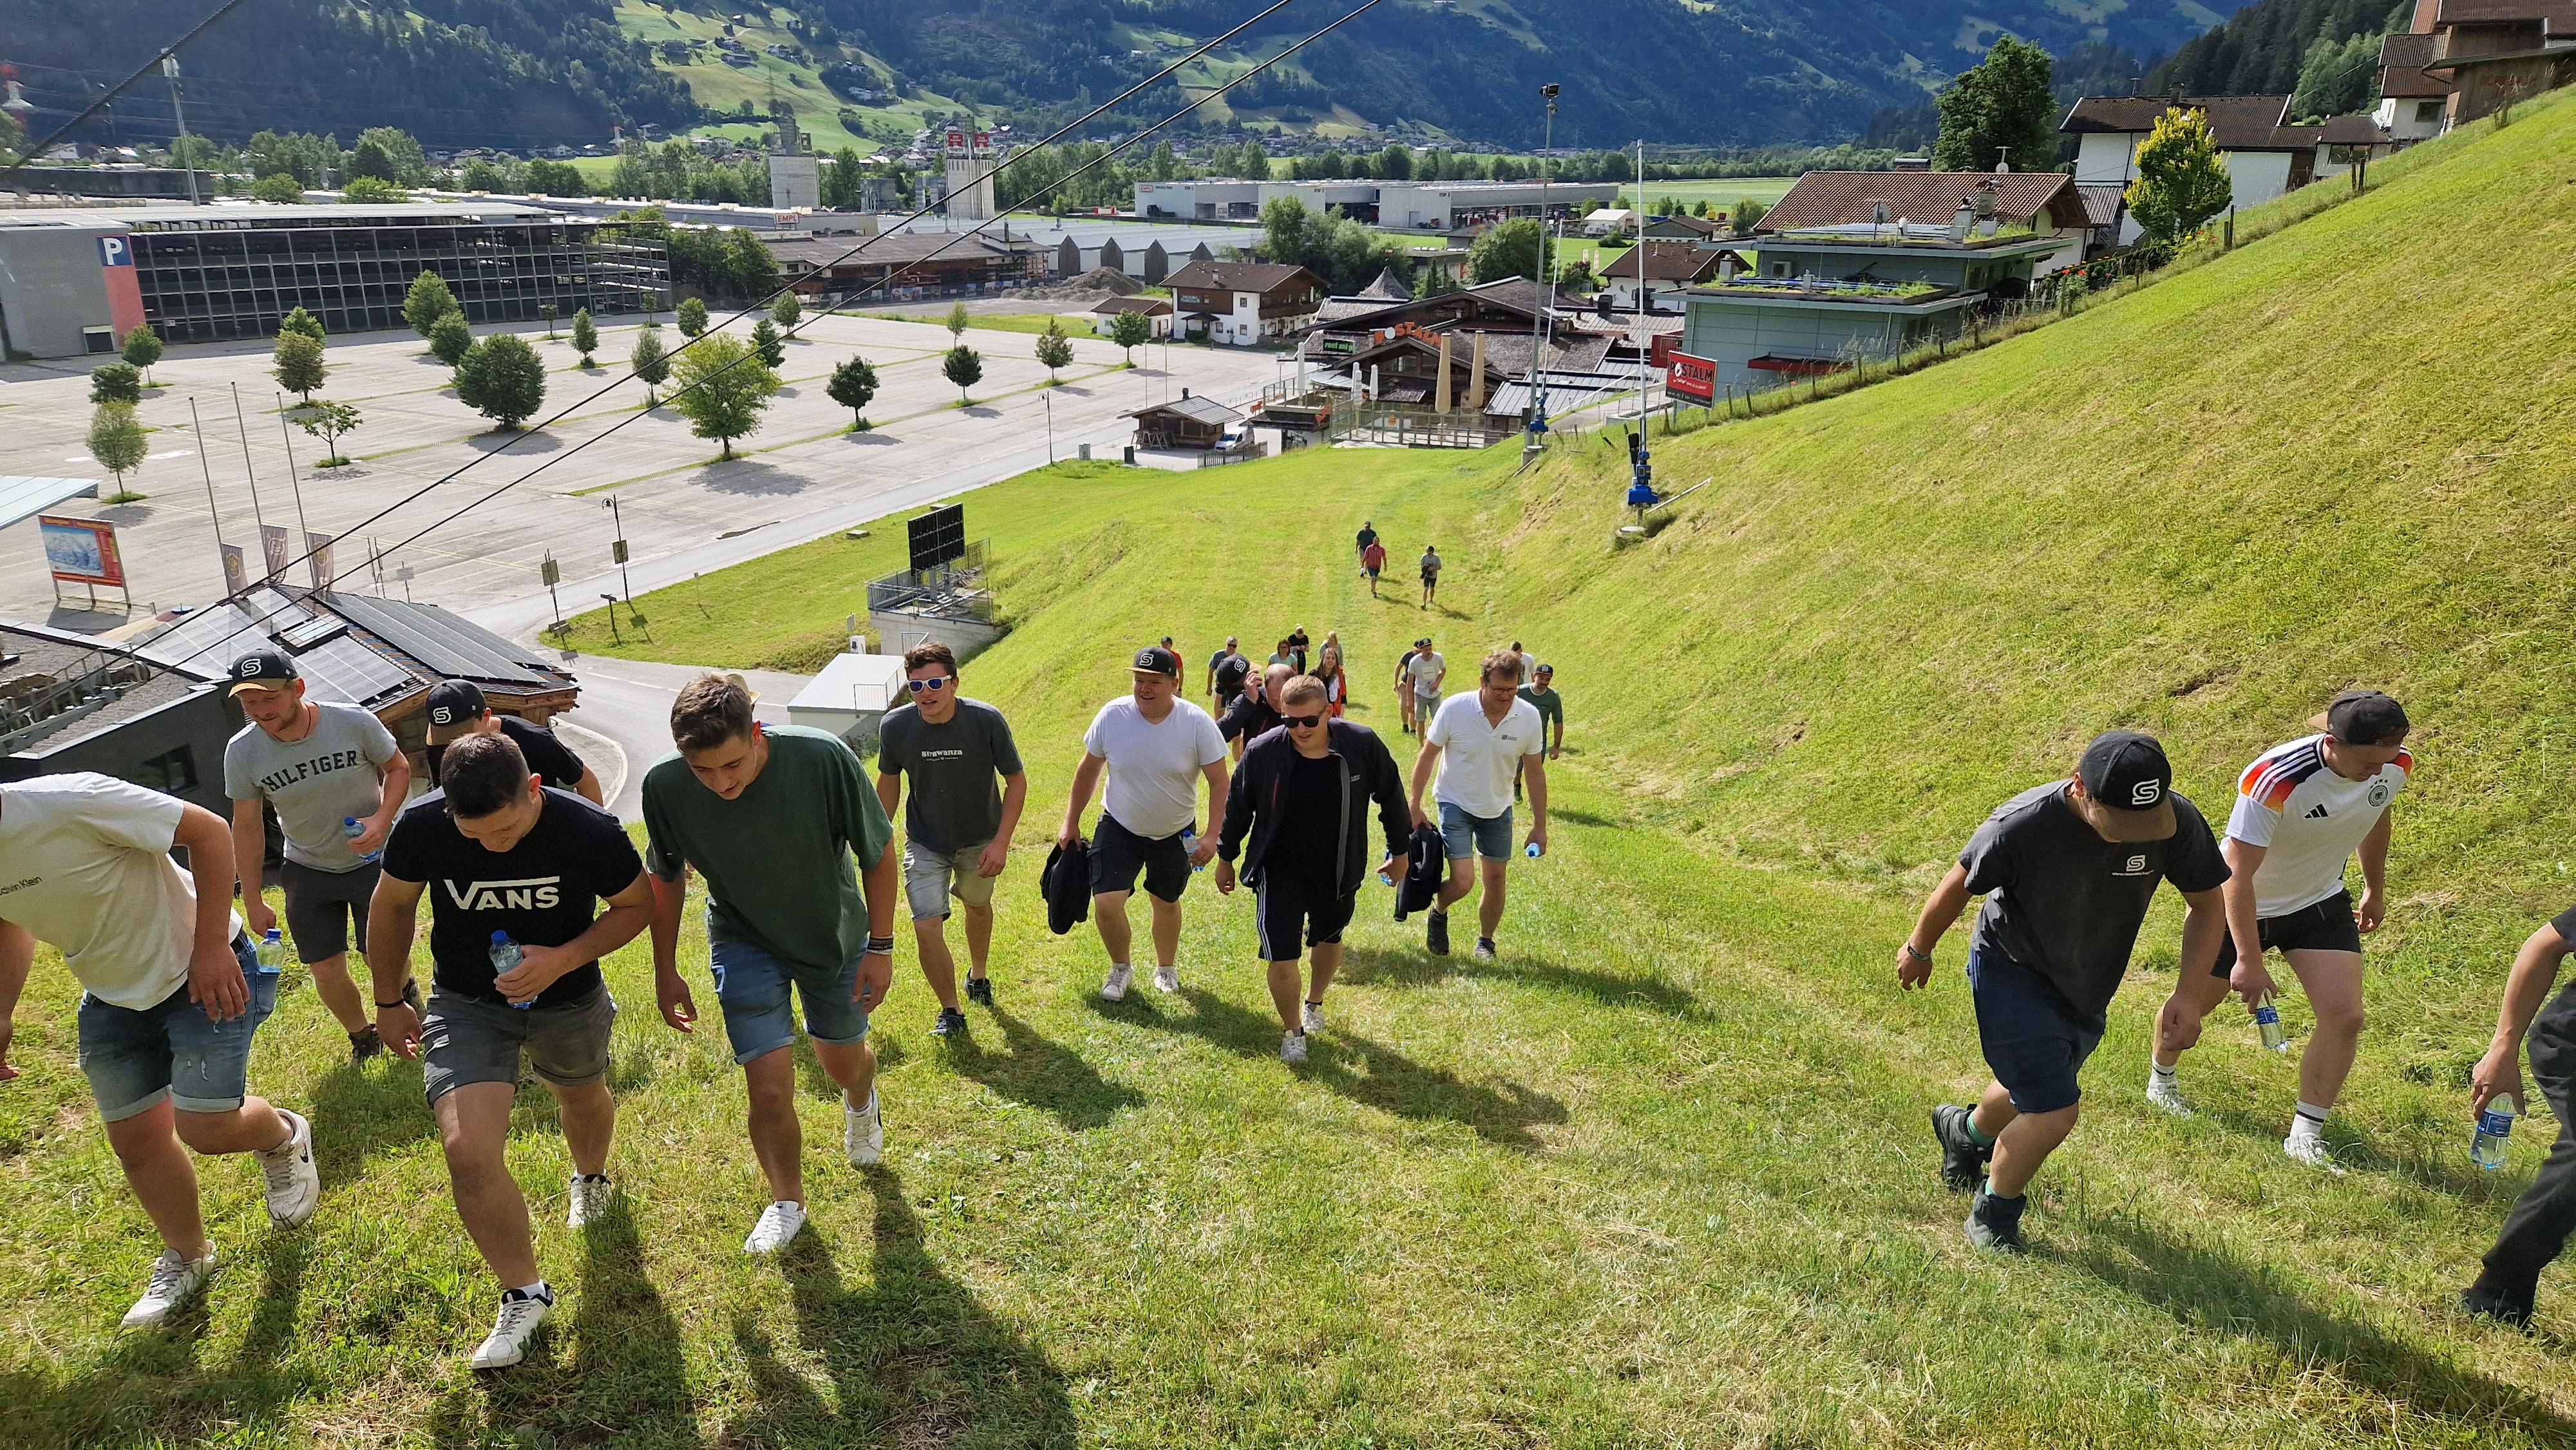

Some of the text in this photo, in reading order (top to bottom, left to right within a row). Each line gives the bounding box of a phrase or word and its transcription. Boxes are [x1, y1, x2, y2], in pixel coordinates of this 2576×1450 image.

[103, 238, 122, 265] P
[1374, 321, 1443, 348] POSTALM
[1669, 359, 1713, 383] POSTALM
[241, 658, 261, 677] S
[1139, 653, 1154, 666] S
[433, 706, 451, 724] S
[260, 749, 357, 793] HILFIGER
[2132, 778, 2160, 805] S
[2126, 854, 2146, 872] S
[0, 876, 43, 896] alvin Klein
[443, 876, 560, 910] VANS
